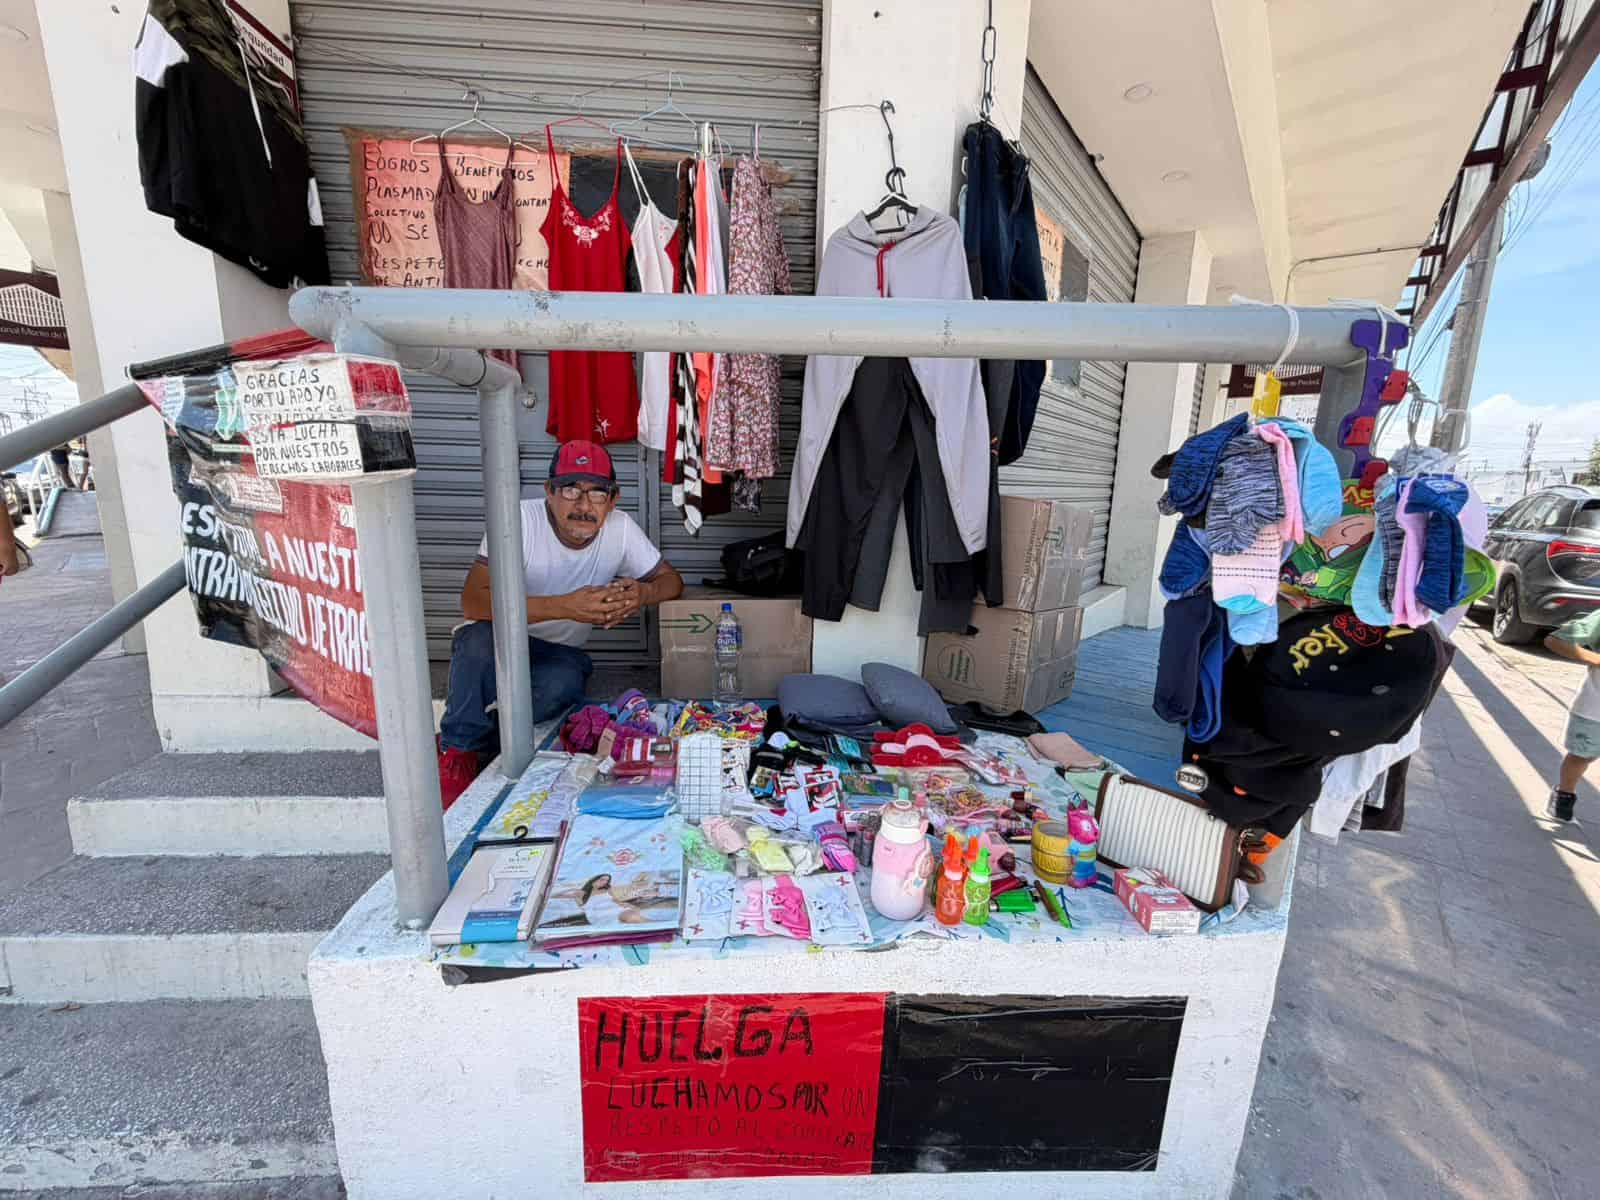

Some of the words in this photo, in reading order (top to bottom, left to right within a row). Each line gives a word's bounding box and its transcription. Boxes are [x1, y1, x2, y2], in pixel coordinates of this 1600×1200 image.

[367, 176, 436, 201] PLASMAD
[406, 224, 430, 241] SE
[246, 368, 321, 391] GRACIAS
[295, 423, 338, 441] LUCHA
[255, 447, 279, 463] POR
[280, 440, 349, 460] NUESTROS
[312, 459, 363, 473] LABORALES
[595, 1005, 814, 1070] HUELGA
